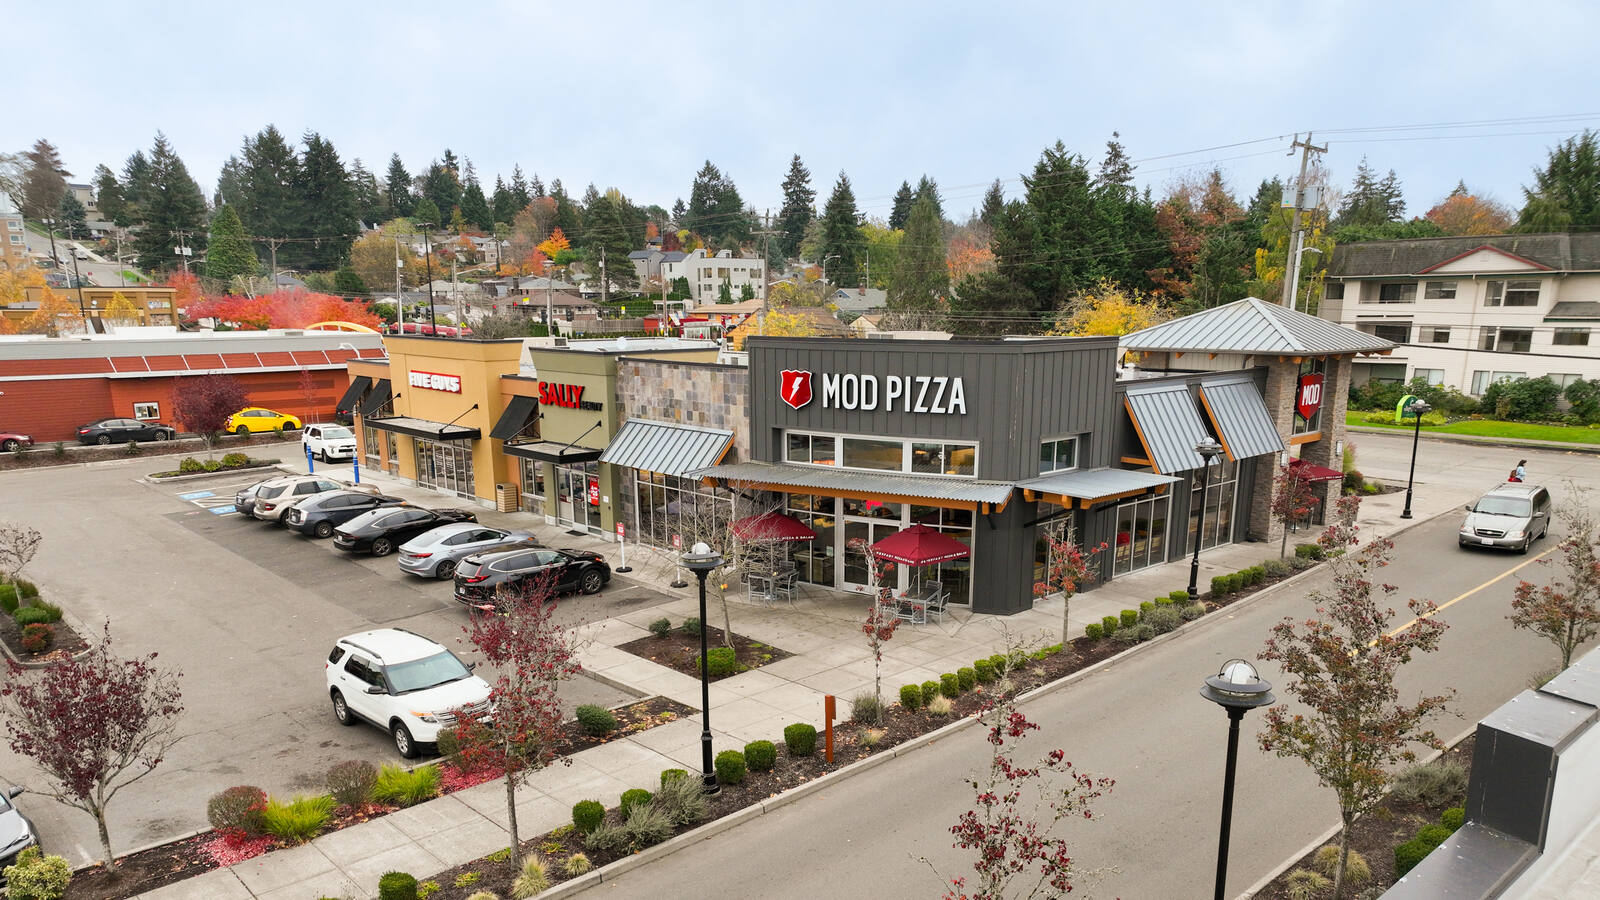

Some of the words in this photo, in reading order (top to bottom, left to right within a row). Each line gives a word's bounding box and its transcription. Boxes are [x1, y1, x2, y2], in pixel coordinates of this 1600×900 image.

[431, 374, 460, 392] GUYS
[538, 381, 585, 409] SALLY
[822, 373, 878, 411] MOD
[886, 375, 967, 415] PIZZA
[1301, 383, 1320, 406] MOD
